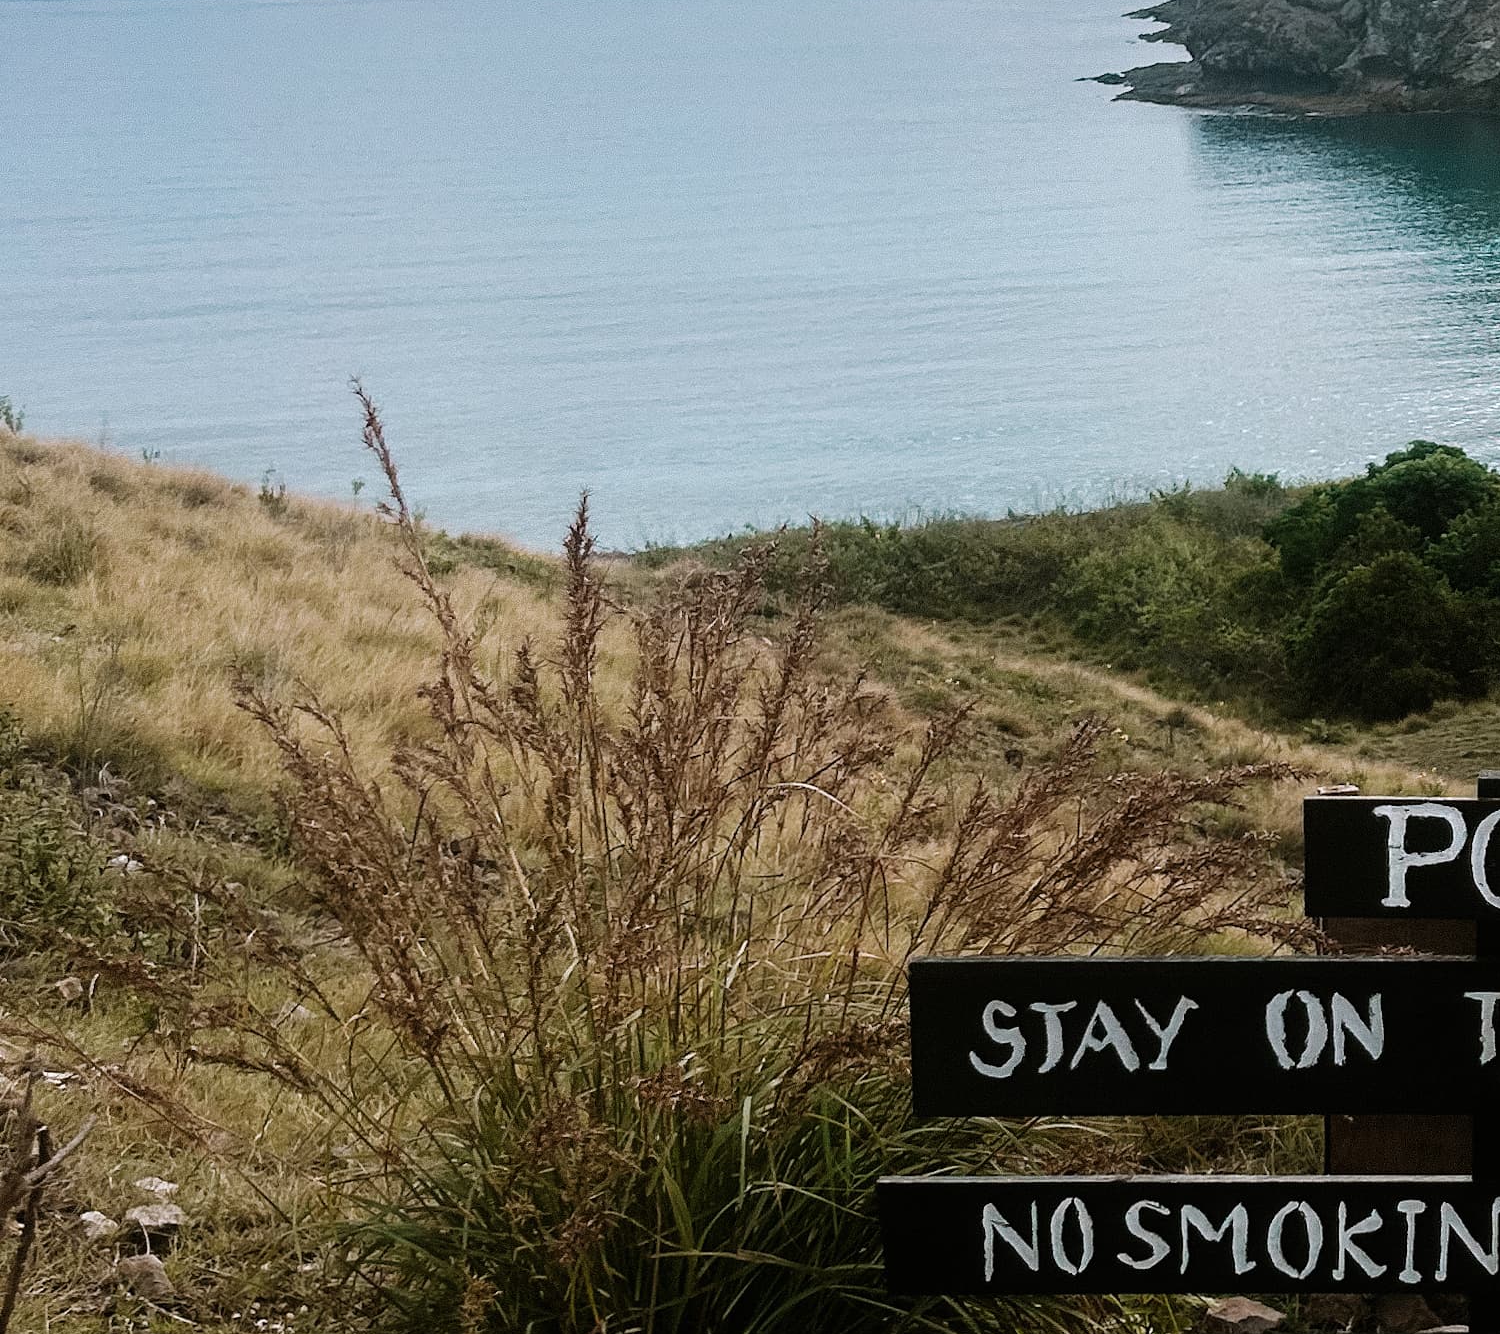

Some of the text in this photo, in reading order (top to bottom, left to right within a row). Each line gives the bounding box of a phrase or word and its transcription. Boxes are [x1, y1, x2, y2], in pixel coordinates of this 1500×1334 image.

[969, 995, 1199, 1078] STAY
[1265, 989, 1384, 1070] ON
[982, 1197, 1093, 1281] NO
